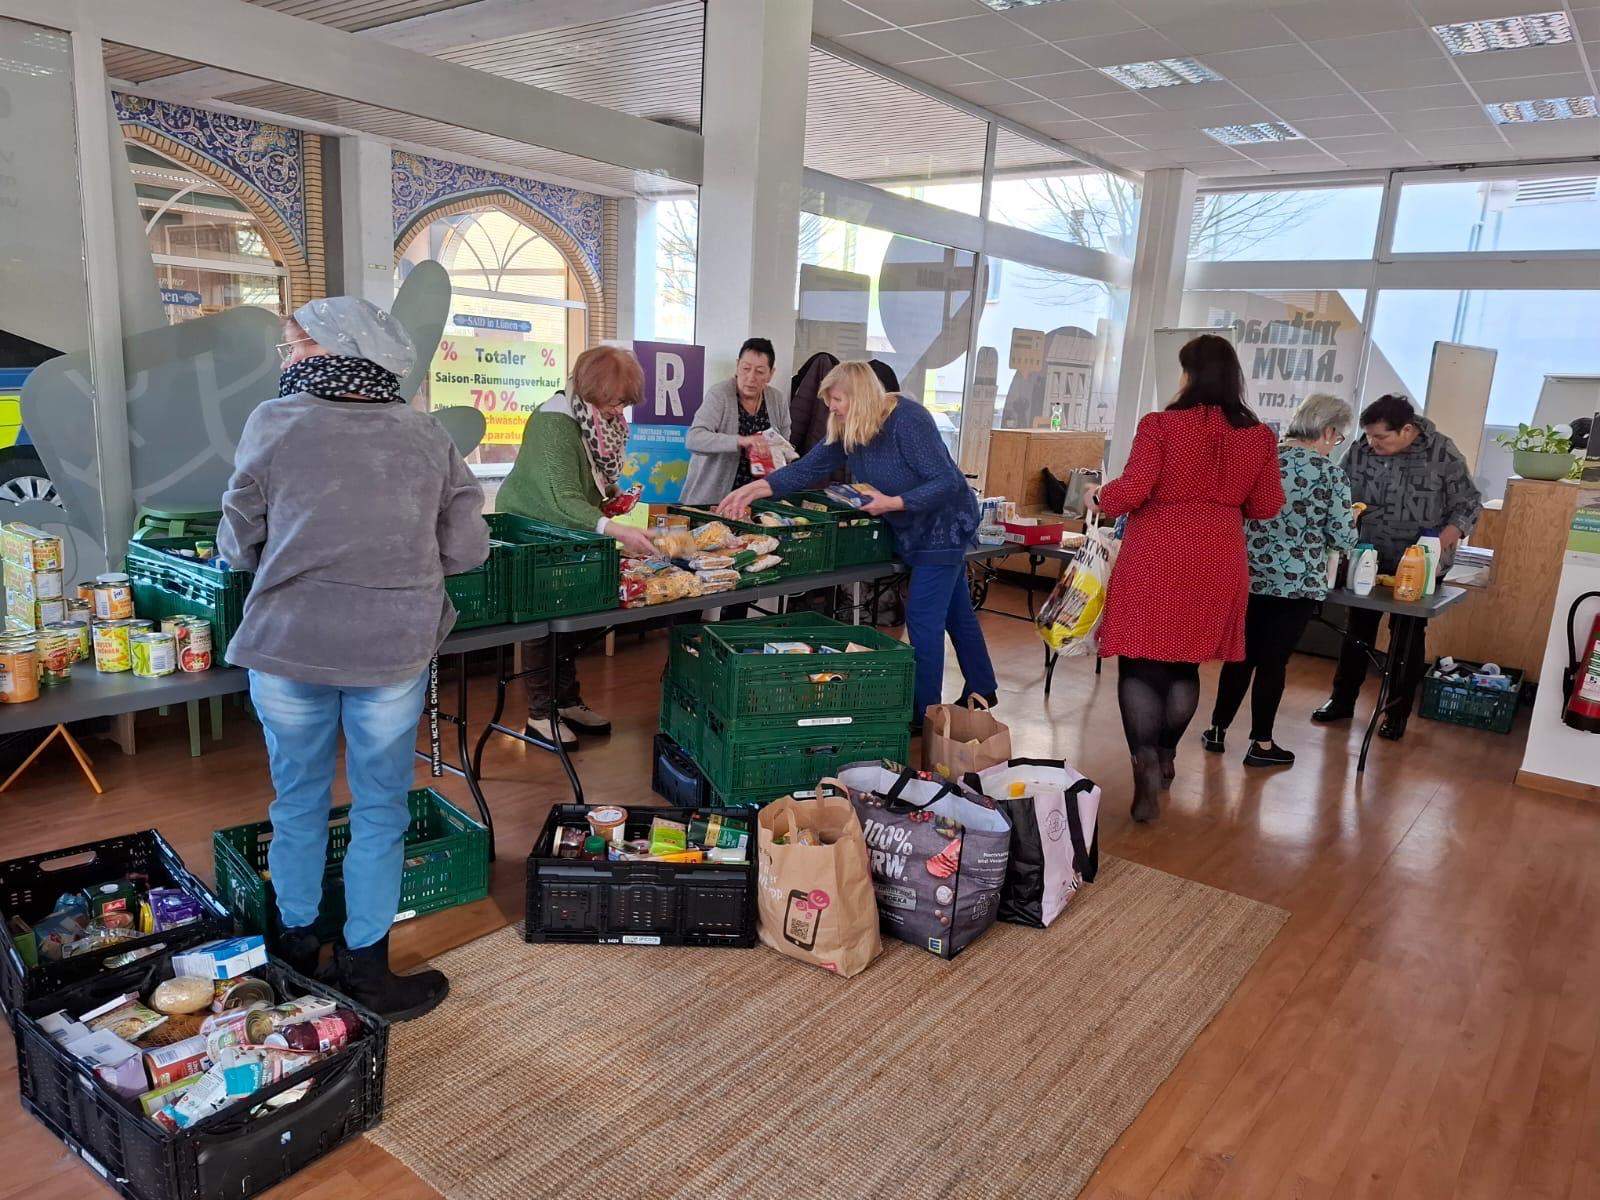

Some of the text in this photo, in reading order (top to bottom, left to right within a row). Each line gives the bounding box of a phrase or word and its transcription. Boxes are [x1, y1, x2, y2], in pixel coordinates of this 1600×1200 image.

[487, 318, 495, 328] in
[475, 347, 526, 365] Totaler
[435, 371, 561, 388] Saison-Räumungsverkauf
[655, 352, 685, 417] R
[520, 403, 541, 412] red
[863, 818, 913, 856] 100%
[867, 848, 909, 882] RW.
